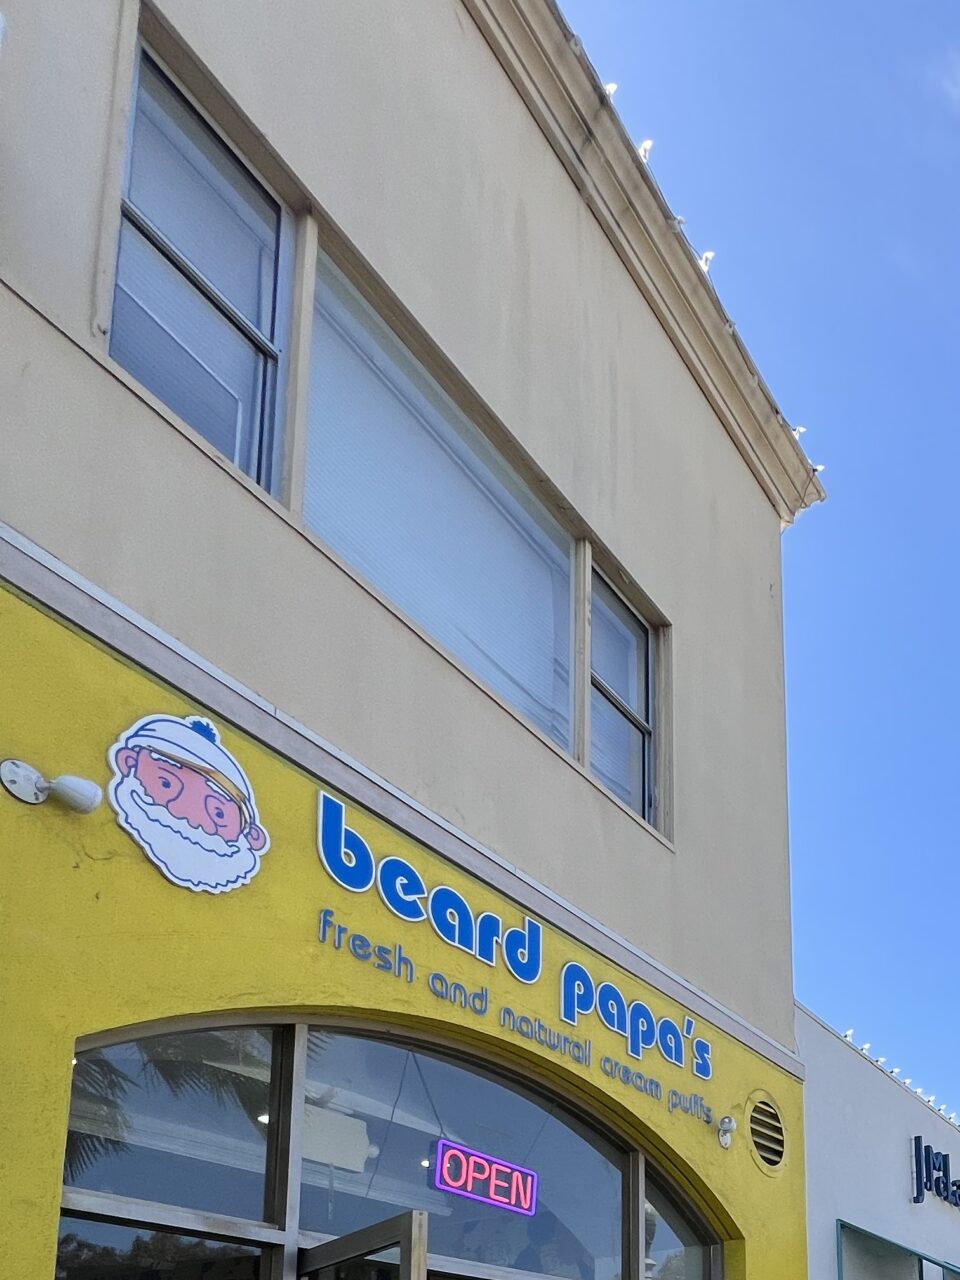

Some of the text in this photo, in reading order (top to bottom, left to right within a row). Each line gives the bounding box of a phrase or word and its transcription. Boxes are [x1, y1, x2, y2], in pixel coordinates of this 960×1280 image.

[317, 790, 713, 1080] beard papa's
[318, 908, 713, 1125] fresh and natural cream puffs
[442, 1149, 532, 1209] OPEN
